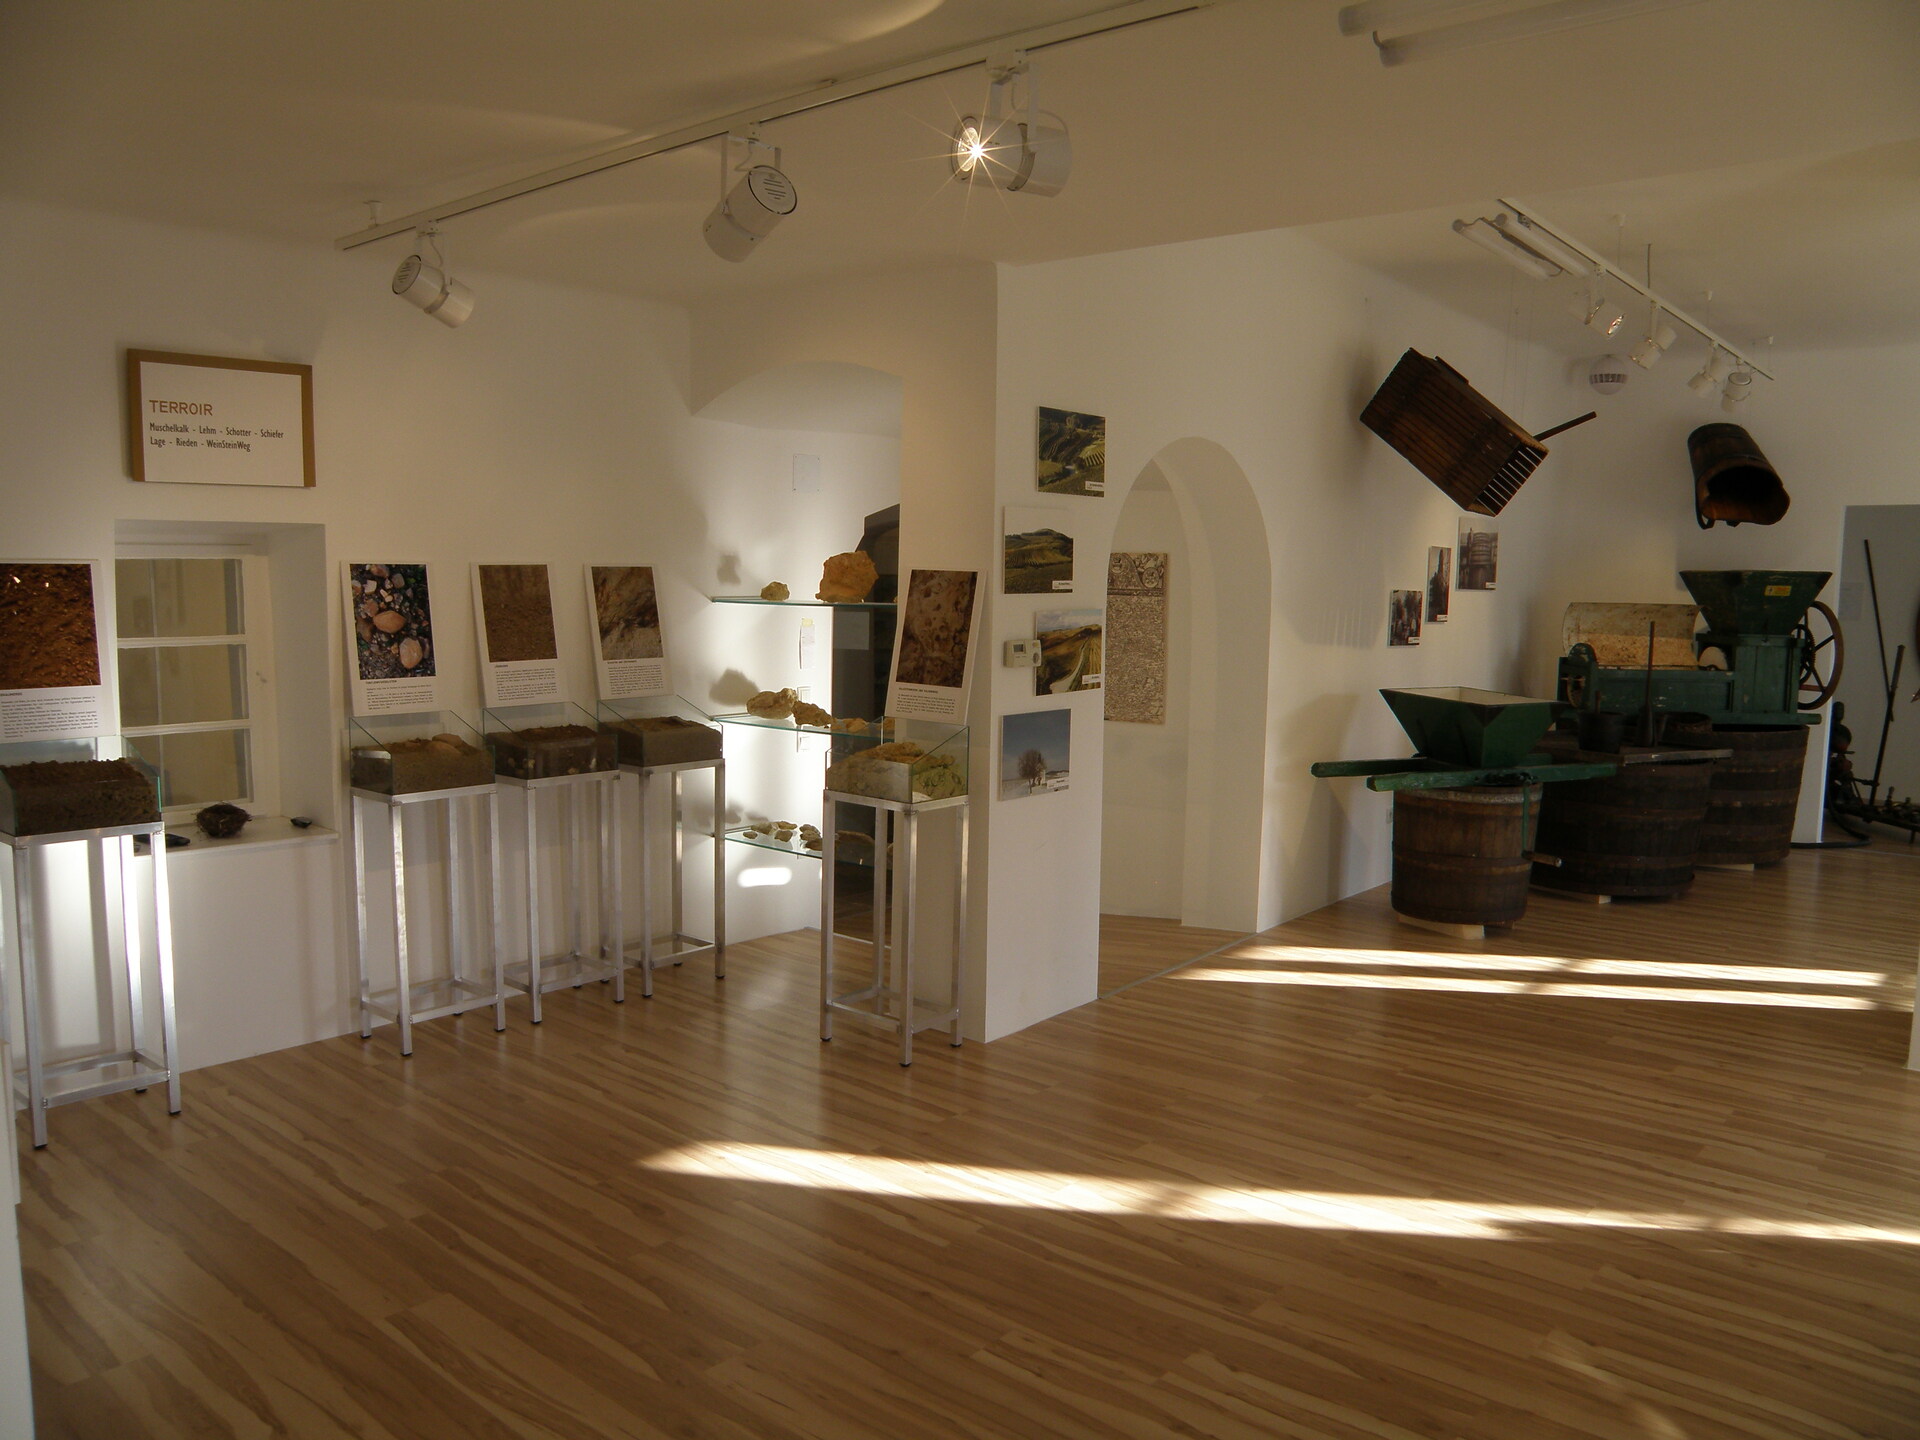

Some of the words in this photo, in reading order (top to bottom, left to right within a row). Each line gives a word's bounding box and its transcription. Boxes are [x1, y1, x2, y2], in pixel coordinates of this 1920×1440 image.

[149, 399, 213, 416] TERROIR
[149, 422, 189, 433] Muschelkalk
[199, 425, 217, 435] Lehm
[225, 426, 252, 437] Schotter
[260, 428, 284, 439] Schiefer
[150, 436, 166, 448] Lage
[176, 438, 198, 447] Rieden
[206, 439, 251, 452] WeinSteinWeg
